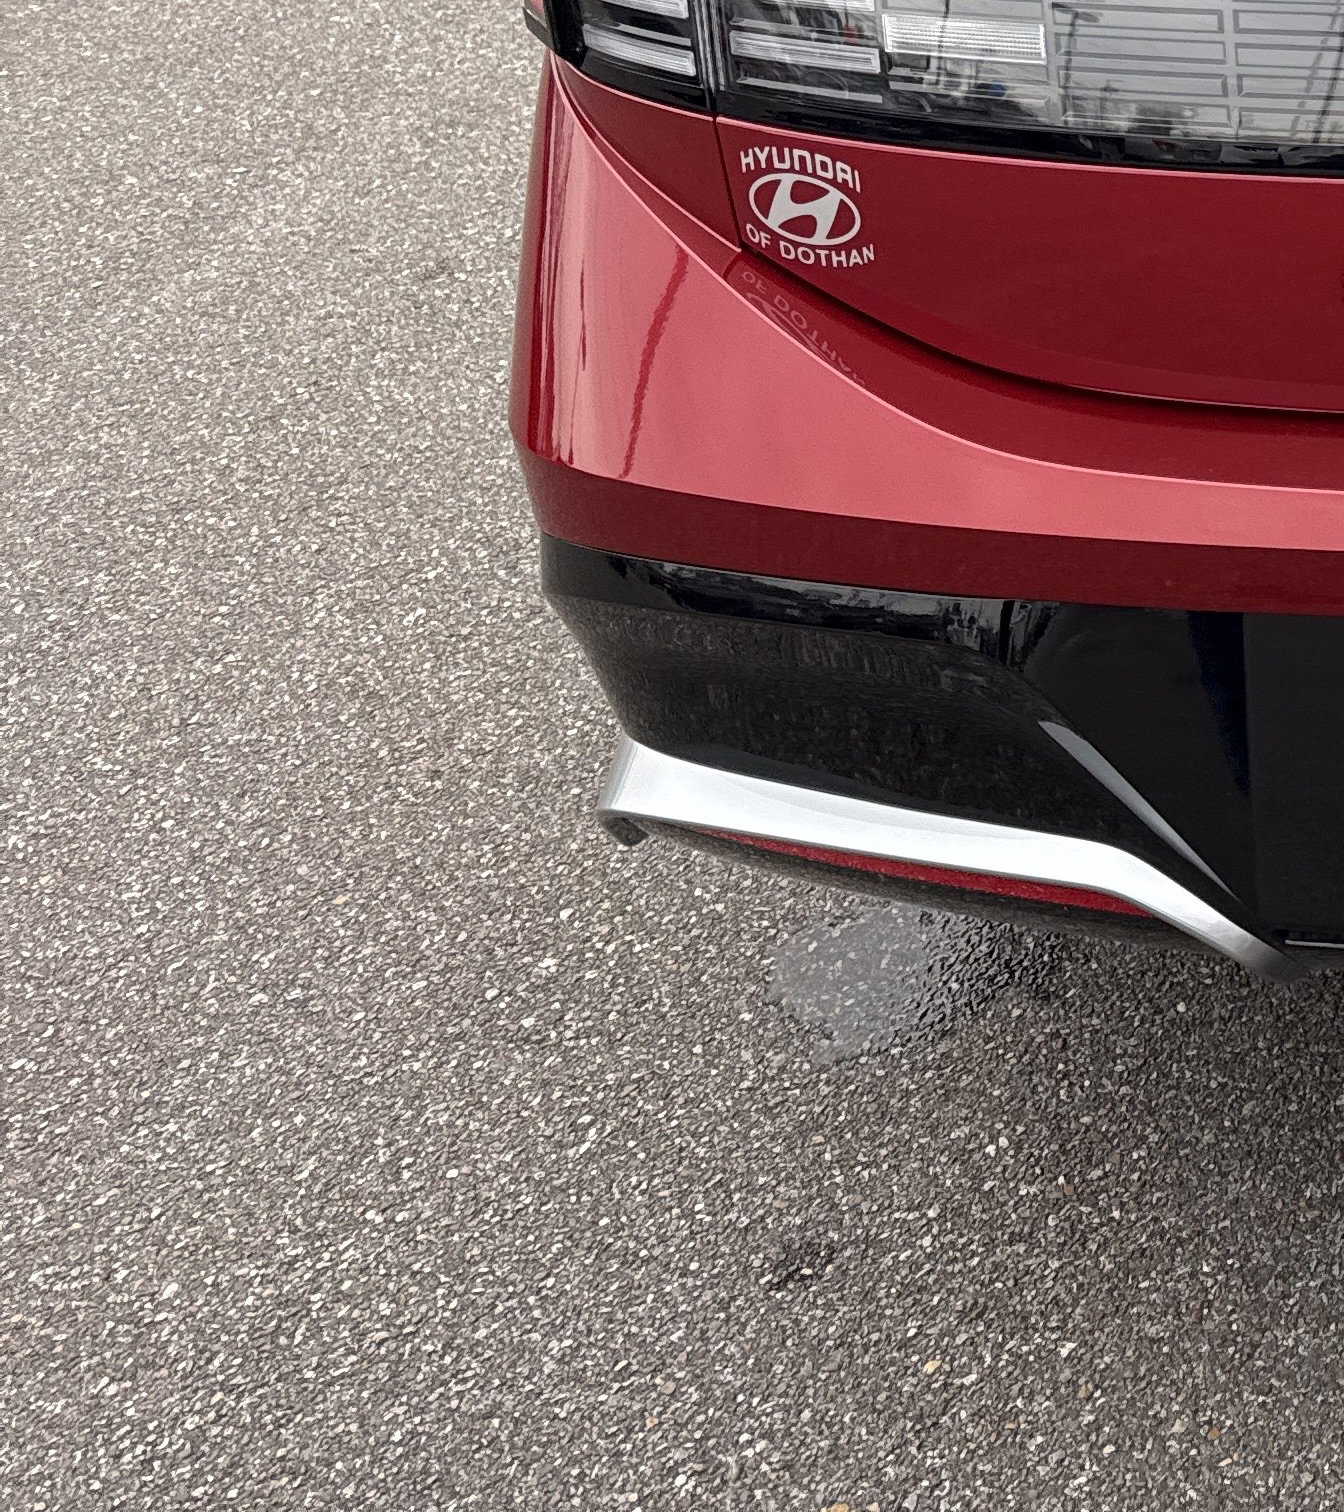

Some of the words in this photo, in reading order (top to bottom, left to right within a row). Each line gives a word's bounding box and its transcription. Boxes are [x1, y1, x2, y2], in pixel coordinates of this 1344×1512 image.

[740, 146, 861, 193] HYUNDAI
[745, 223, 771, 248] OF
[779, 240, 875, 267] DOTHAN
